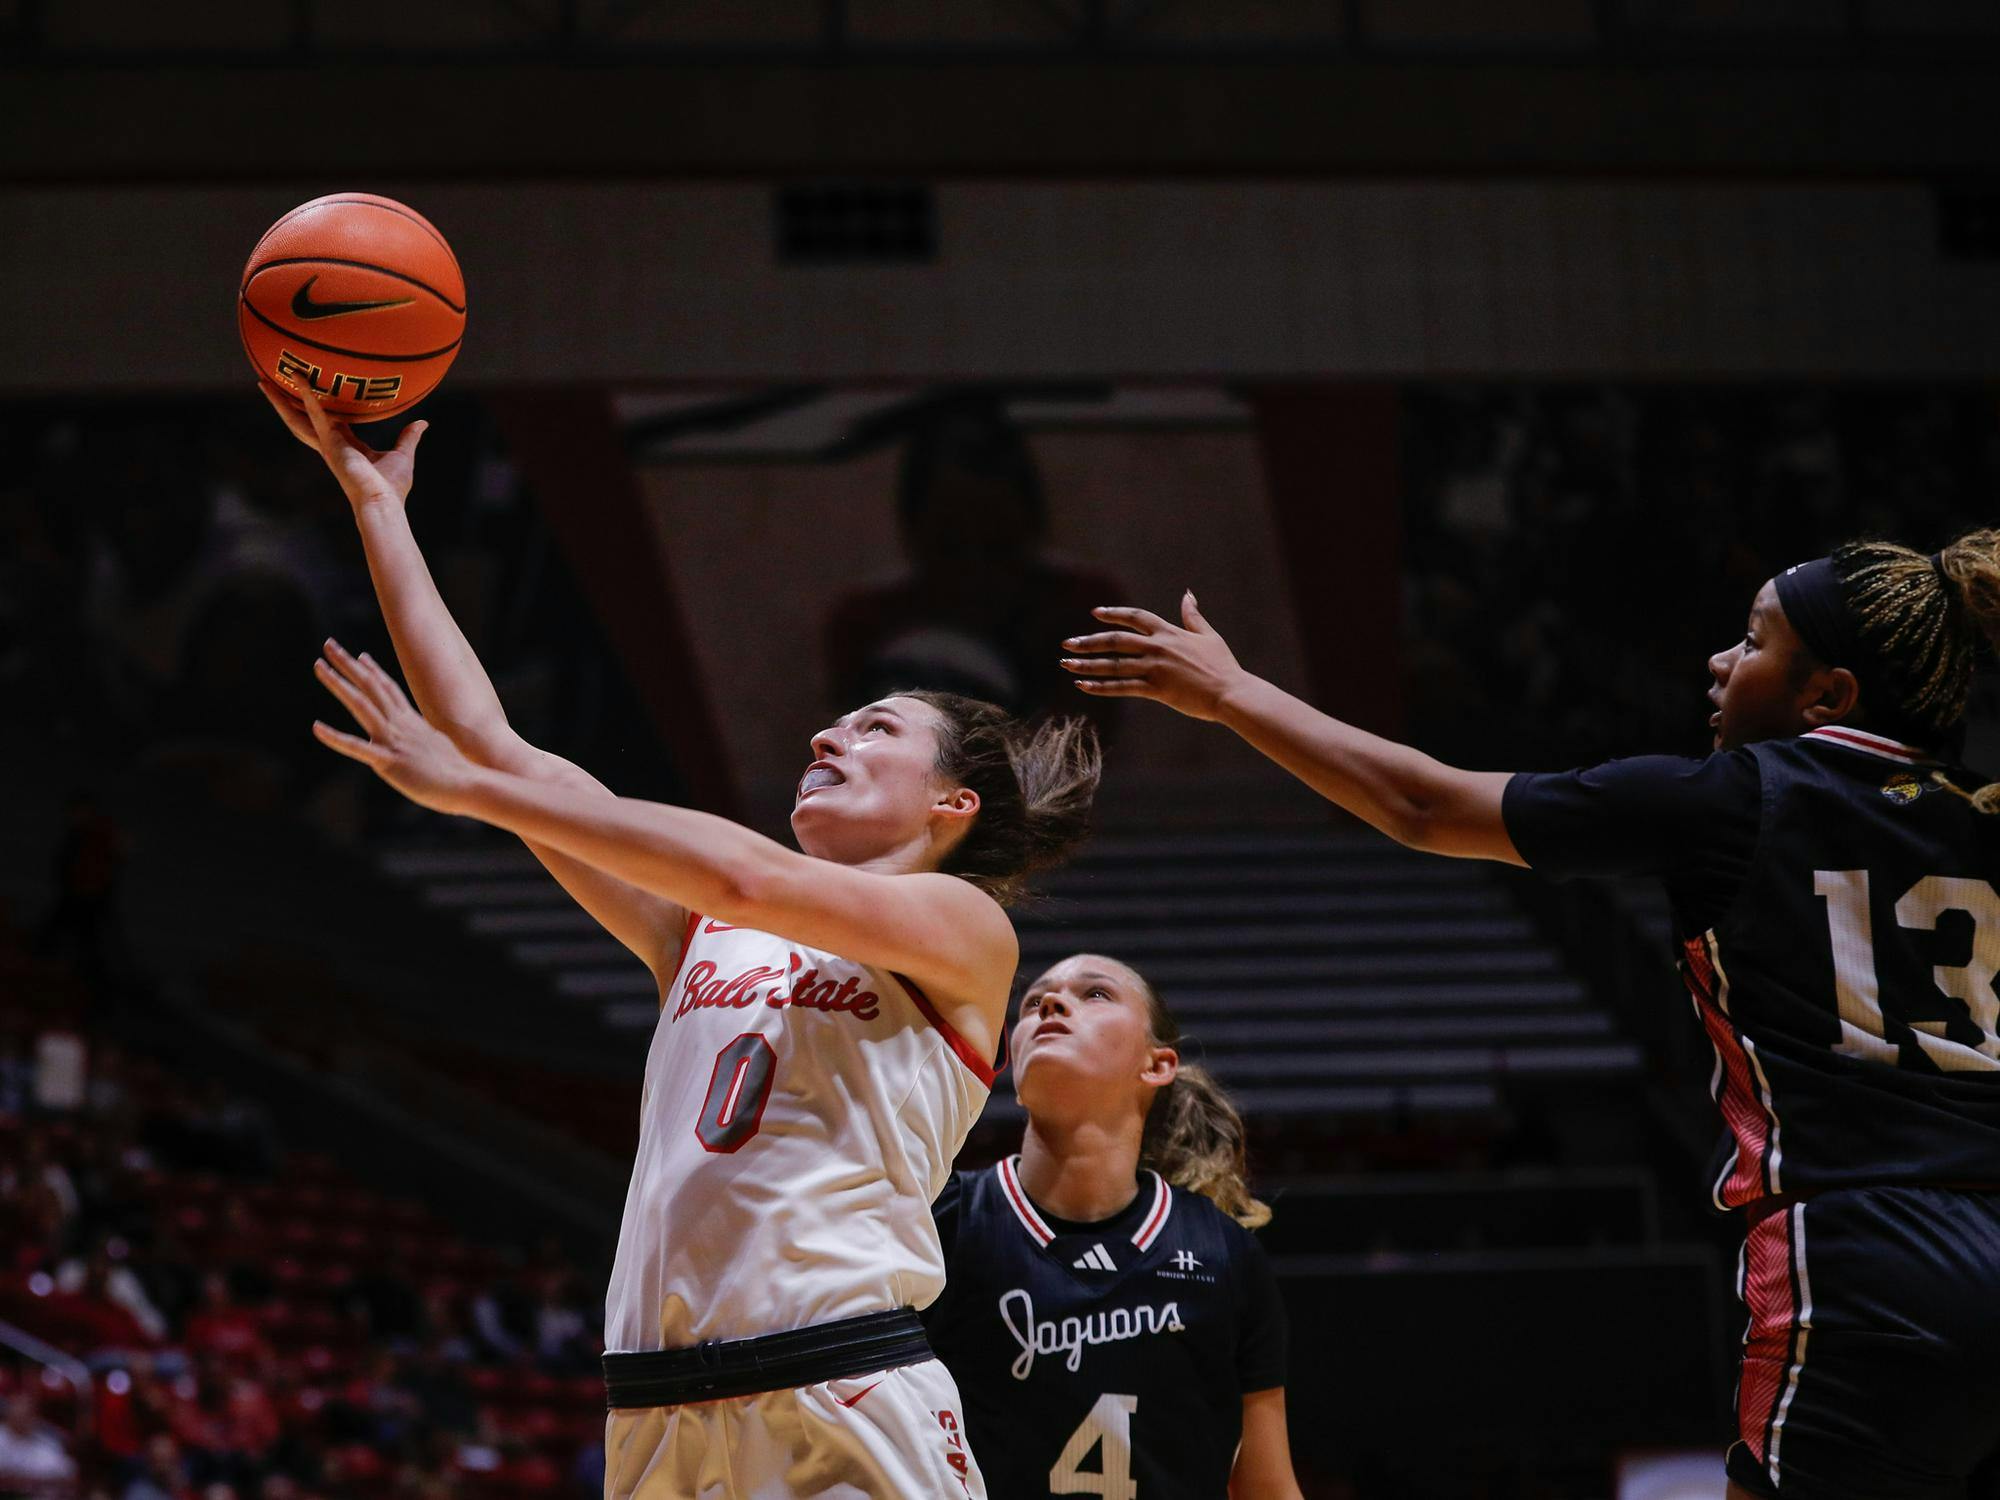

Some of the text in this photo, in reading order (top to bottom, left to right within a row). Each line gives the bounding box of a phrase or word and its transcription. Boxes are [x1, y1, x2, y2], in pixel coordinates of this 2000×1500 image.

[276, 348, 402, 400] ELITE
[673, 952, 879, 1023] Ball State
[1813, 869, 2000, 1072] 13
[695, 1033, 777, 1154] 0
[999, 1288, 1185, 1380] Jaguars
[1050, 1393, 1138, 1500] 4
